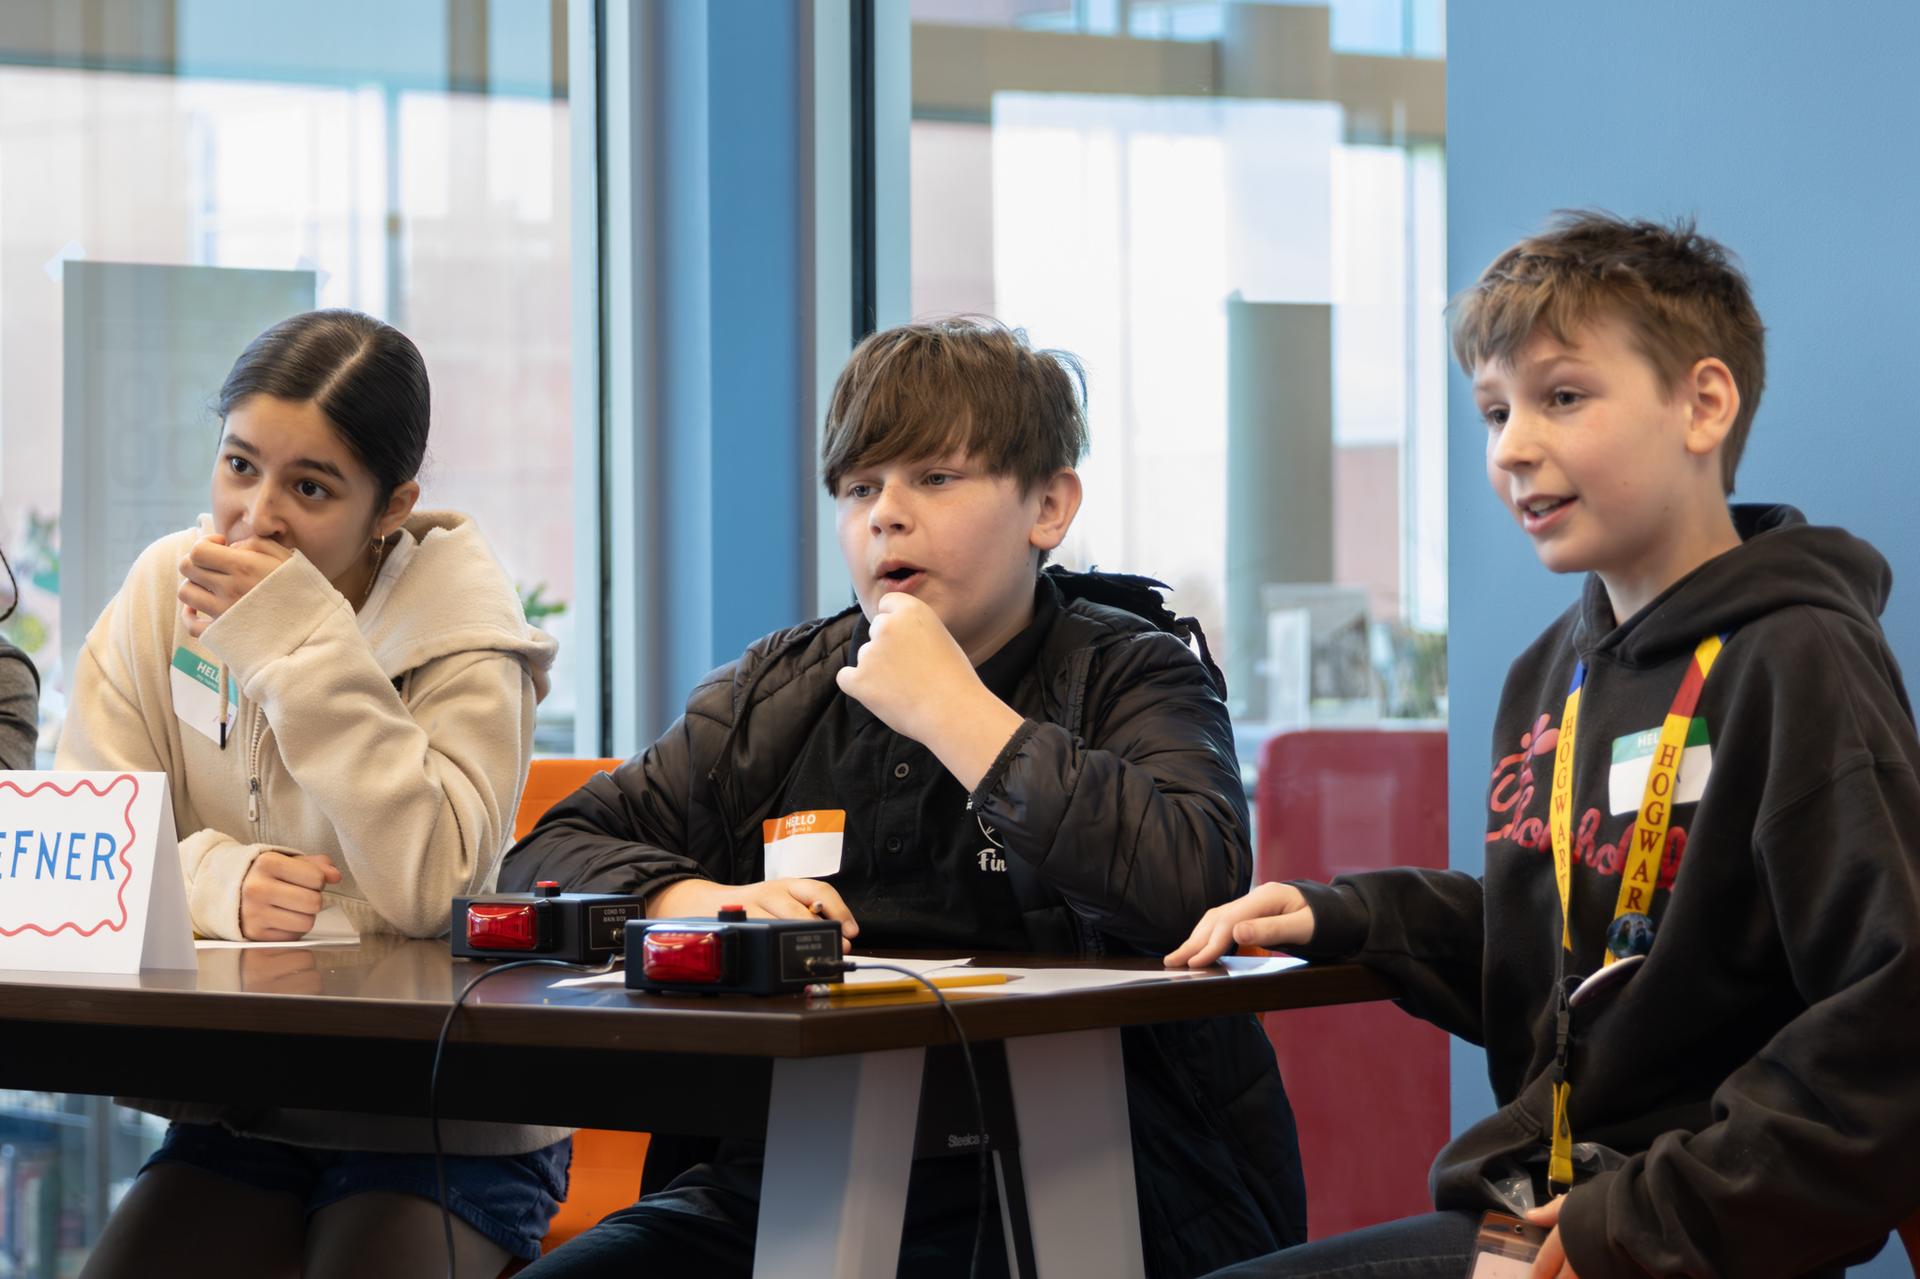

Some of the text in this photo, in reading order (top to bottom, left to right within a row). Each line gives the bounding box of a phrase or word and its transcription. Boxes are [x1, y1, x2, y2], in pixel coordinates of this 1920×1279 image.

[1637, 732, 1658, 748] HEL
[1554, 716, 1575, 904] HOGWART
[785, 814, 816, 829] HELLO
[1625, 744, 1678, 910] HOGWAR
[947, 1133, 990, 1148] Steelcae
